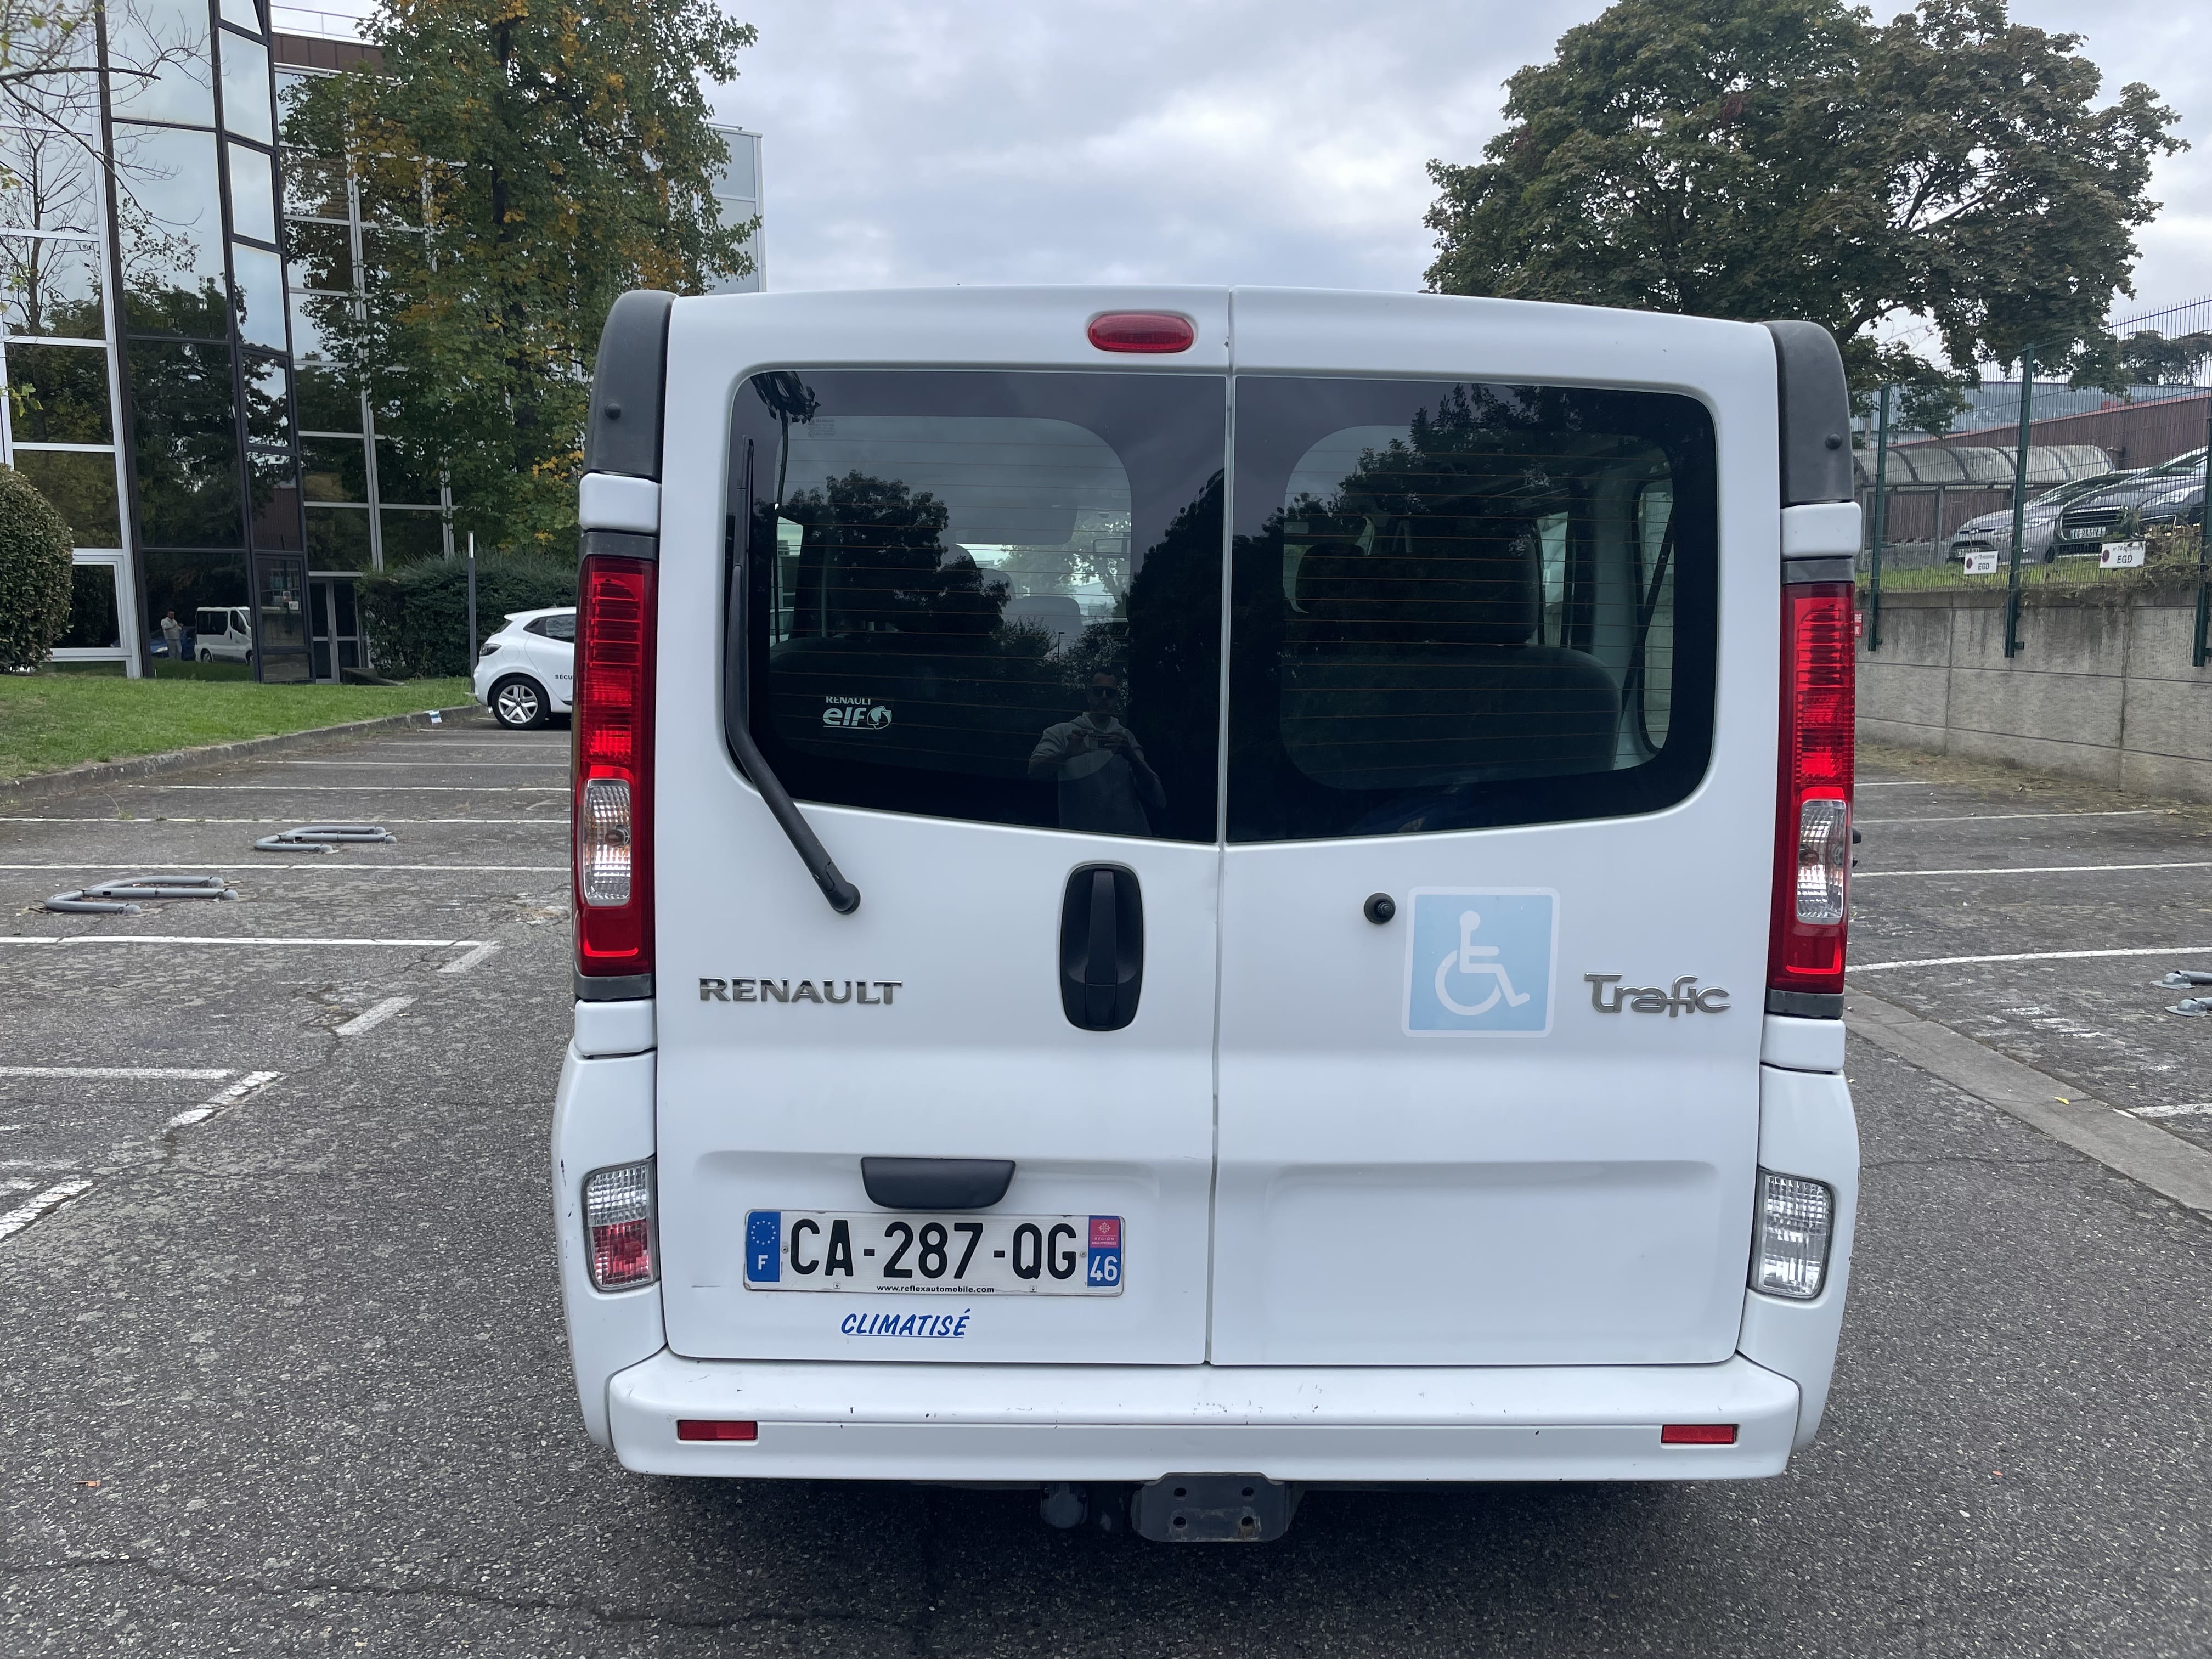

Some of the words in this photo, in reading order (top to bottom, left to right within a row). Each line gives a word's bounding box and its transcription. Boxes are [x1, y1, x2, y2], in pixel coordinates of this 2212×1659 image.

[1978, 562, 1990, 571] EGD
[2117, 555, 2132, 564] EGD
[825, 696, 872, 706] RENAULT
[822, 707, 867, 726] elf
[698, 976, 903, 1005] RENAULT
[1584, 972, 1731, 1018] Trafic
[790, 1218, 1077, 1280] CA-287-QG
[758, 1254, 769, 1271] F
[1090, 1255, 1118, 1282] 46
[877, 1285, 995, 1293] www.reflexautomobile.com
[840, 1308, 971, 1337] CLIMATISÉ
